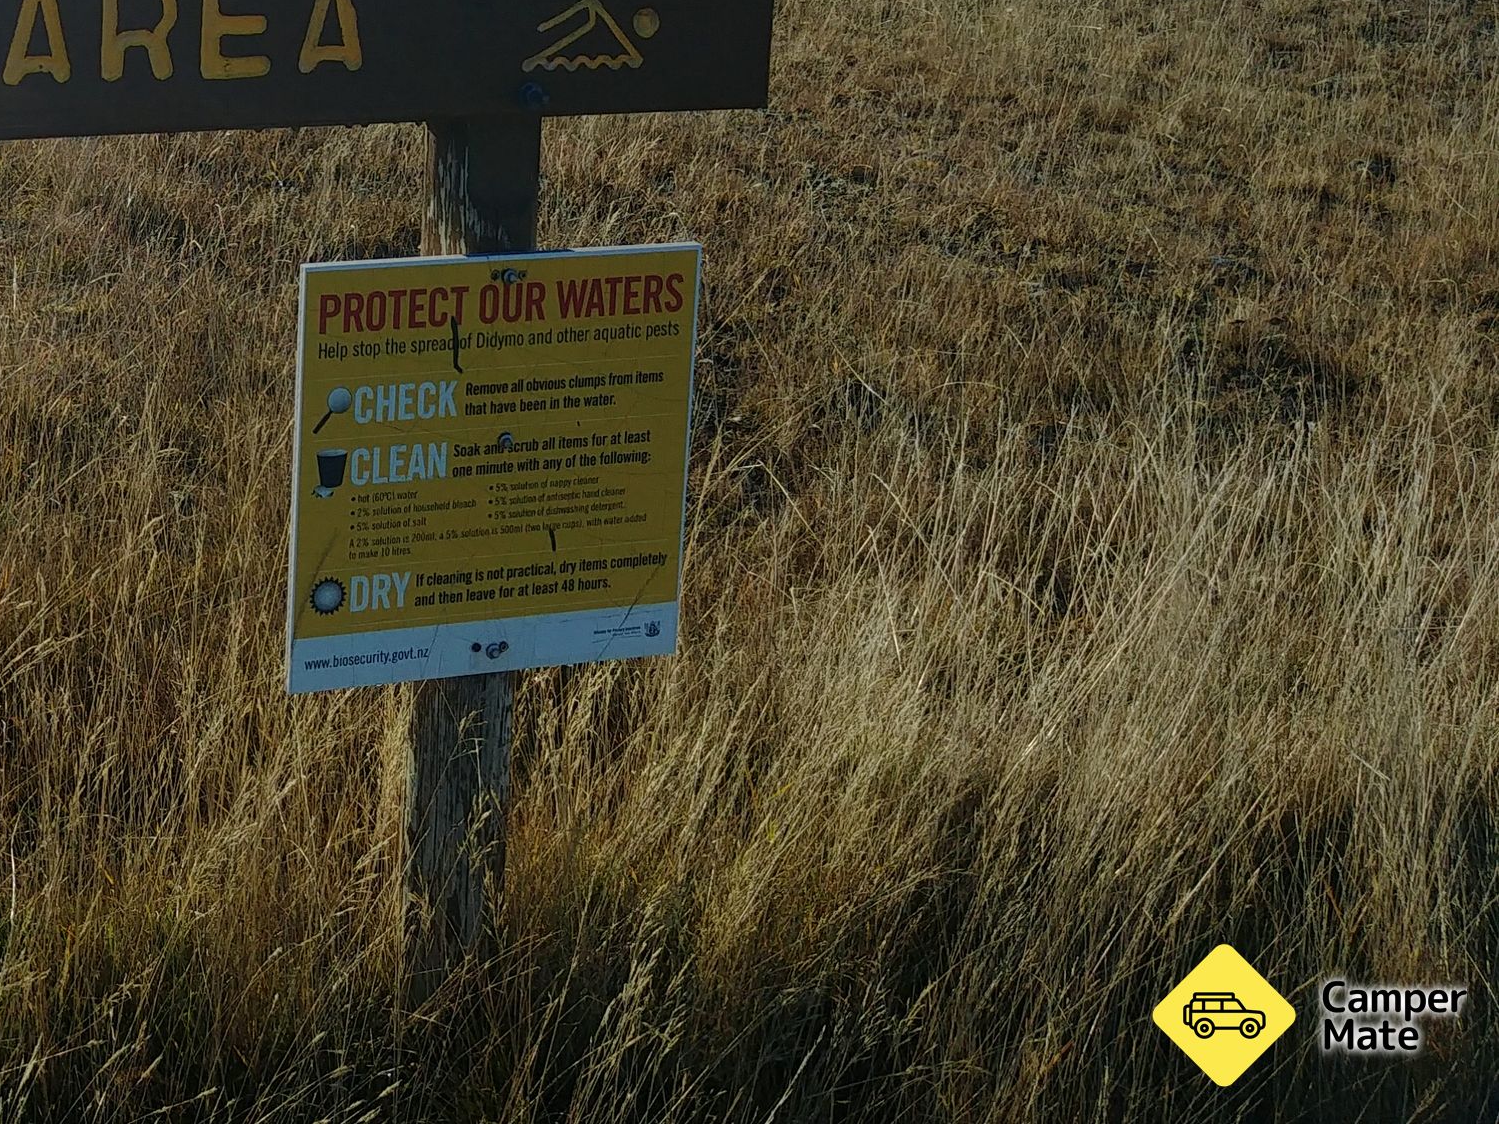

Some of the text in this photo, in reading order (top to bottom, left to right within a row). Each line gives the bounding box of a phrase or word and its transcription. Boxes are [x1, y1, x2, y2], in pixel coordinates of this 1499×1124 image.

[318, 273, 684, 335] PROTECT OUR WATERS
[318, 320, 680, 361] Help stop the spread of Didymo and other aquatic pests
[465, 370, 664, 396] Remove all obvious clumps from items
[354, 379, 458, 424] CHECK
[465, 393, 616, 416] that have been in the water.
[453, 443, 481, 457] Soak
[542, 436, 555, 450] all
[558, 435, 589, 449] items
[591, 433, 608, 447] for
[610, 431, 621, 445] at
[624, 429, 651, 443] least
[350, 441, 448, 485] CLEAN
[452, 450, 652, 478] one minute with any of the following:
[357, 493, 371, 503] hot
[397, 490, 419, 500] water
[494, 487, 626, 506] 5% solution of antiseptic hand cleaner
[495, 476, 599, 492] 5% solution of nappy cleaner
[357, 499, 477, 517] 2% solution of household bleach
[494, 510, 506, 520] 5%
[508, 508, 536, 519] solution
[537, 507, 544, 517] of
[545, 504, 589, 516] dishwashing
[349, 539, 355, 548] A
[356, 538, 369, 548] 2%
[372, 536, 401, 546] solution
[403, 535, 409, 544] is
[446, 530, 459, 540] 5%
[460, 527, 489, 538] solution
[491, 526, 498, 535] is
[586, 517, 602, 527] with
[603, 516, 623, 525] water
[624, 513, 647, 523] added
[356, 517, 427, 531] 5% solution of salt
[348, 550, 357, 560] to
[358, 549, 378, 559] make
[381, 547, 391, 557] 10
[416, 552, 668, 587] If cleaning is not practical, dry items completely
[349, 571, 412, 613] DRY
[414, 577, 612, 607] and then leave for at least 48 hours.
[304, 647, 430, 671] www.biosecurity.govt.nz
